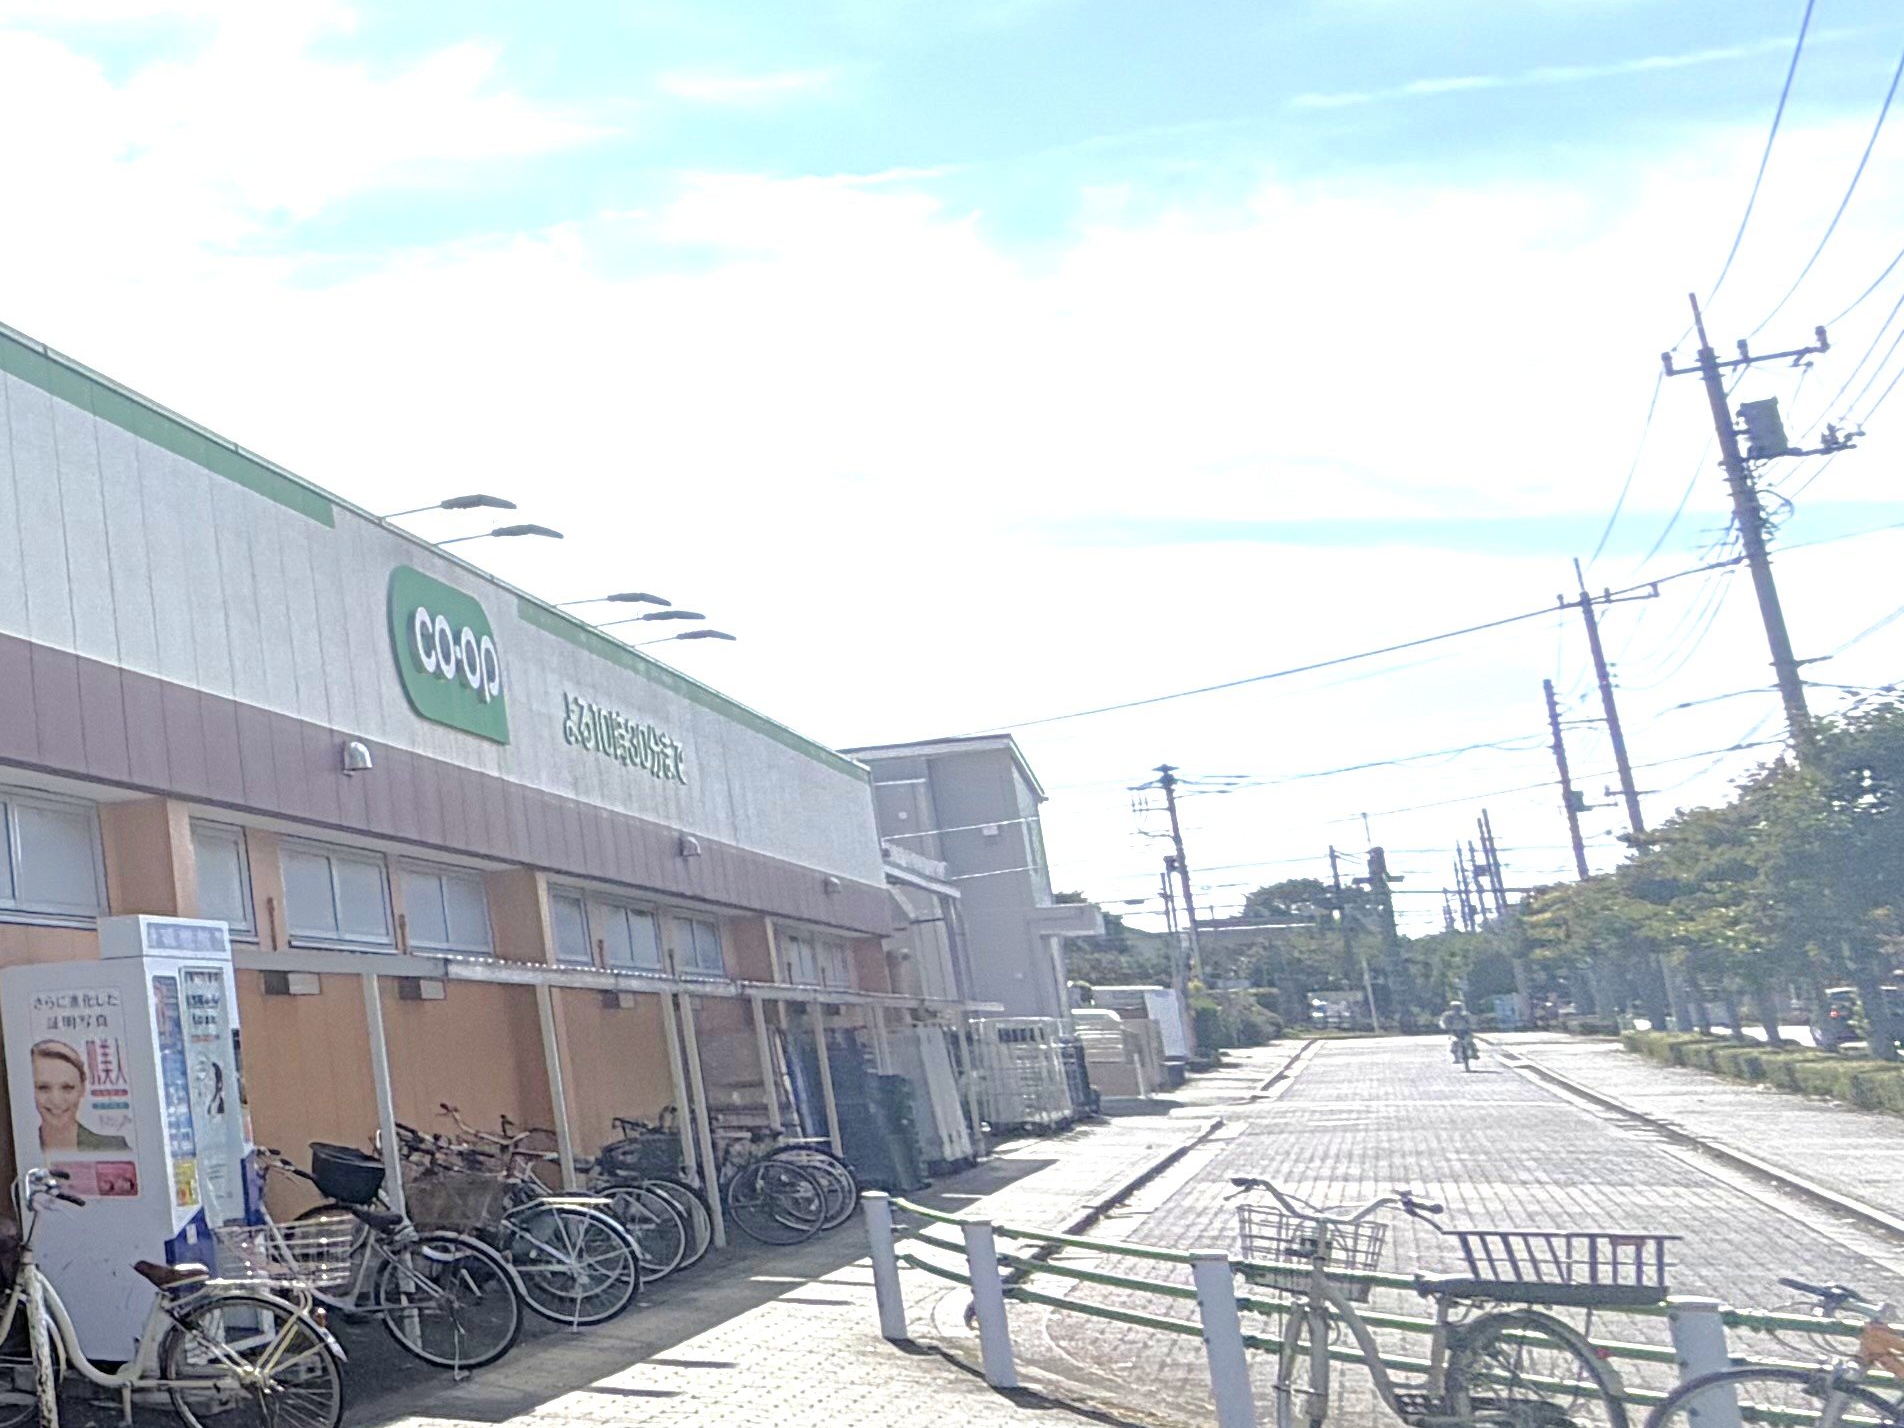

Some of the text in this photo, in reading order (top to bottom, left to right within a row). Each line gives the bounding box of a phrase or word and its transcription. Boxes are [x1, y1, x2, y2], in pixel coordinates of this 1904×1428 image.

[33, 993, 120, 1011] さらに進化した
[46, 1014, 108, 1030] 証明写真
